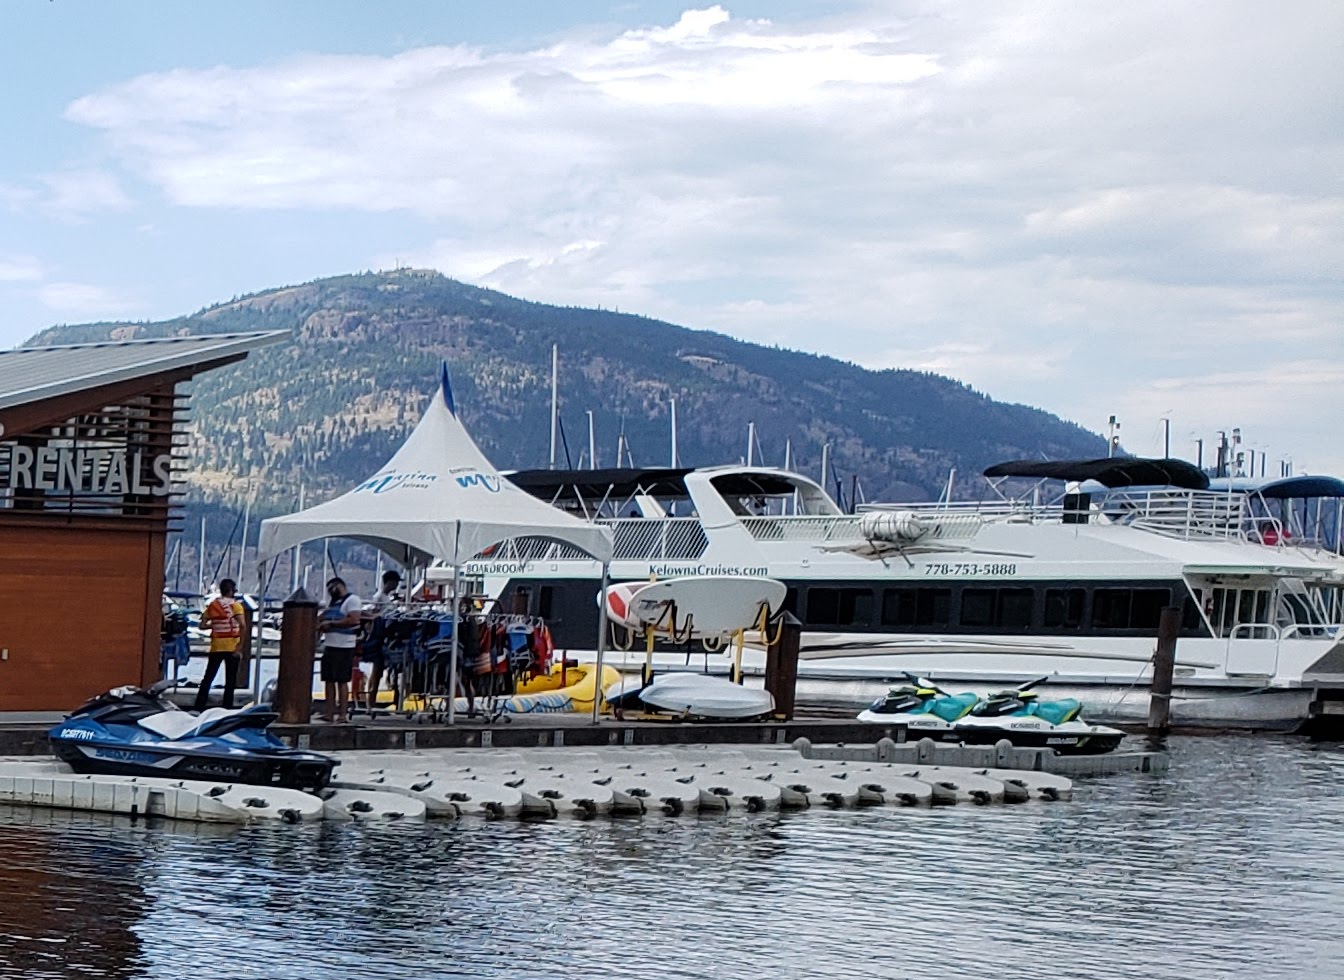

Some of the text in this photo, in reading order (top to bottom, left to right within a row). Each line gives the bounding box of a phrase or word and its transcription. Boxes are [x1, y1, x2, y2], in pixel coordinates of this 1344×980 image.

[10, 445, 171, 496] RENTALS
[649, 564, 768, 576] KelownaCruises.com
[926, 564, 1016, 575] 778-753-5888
